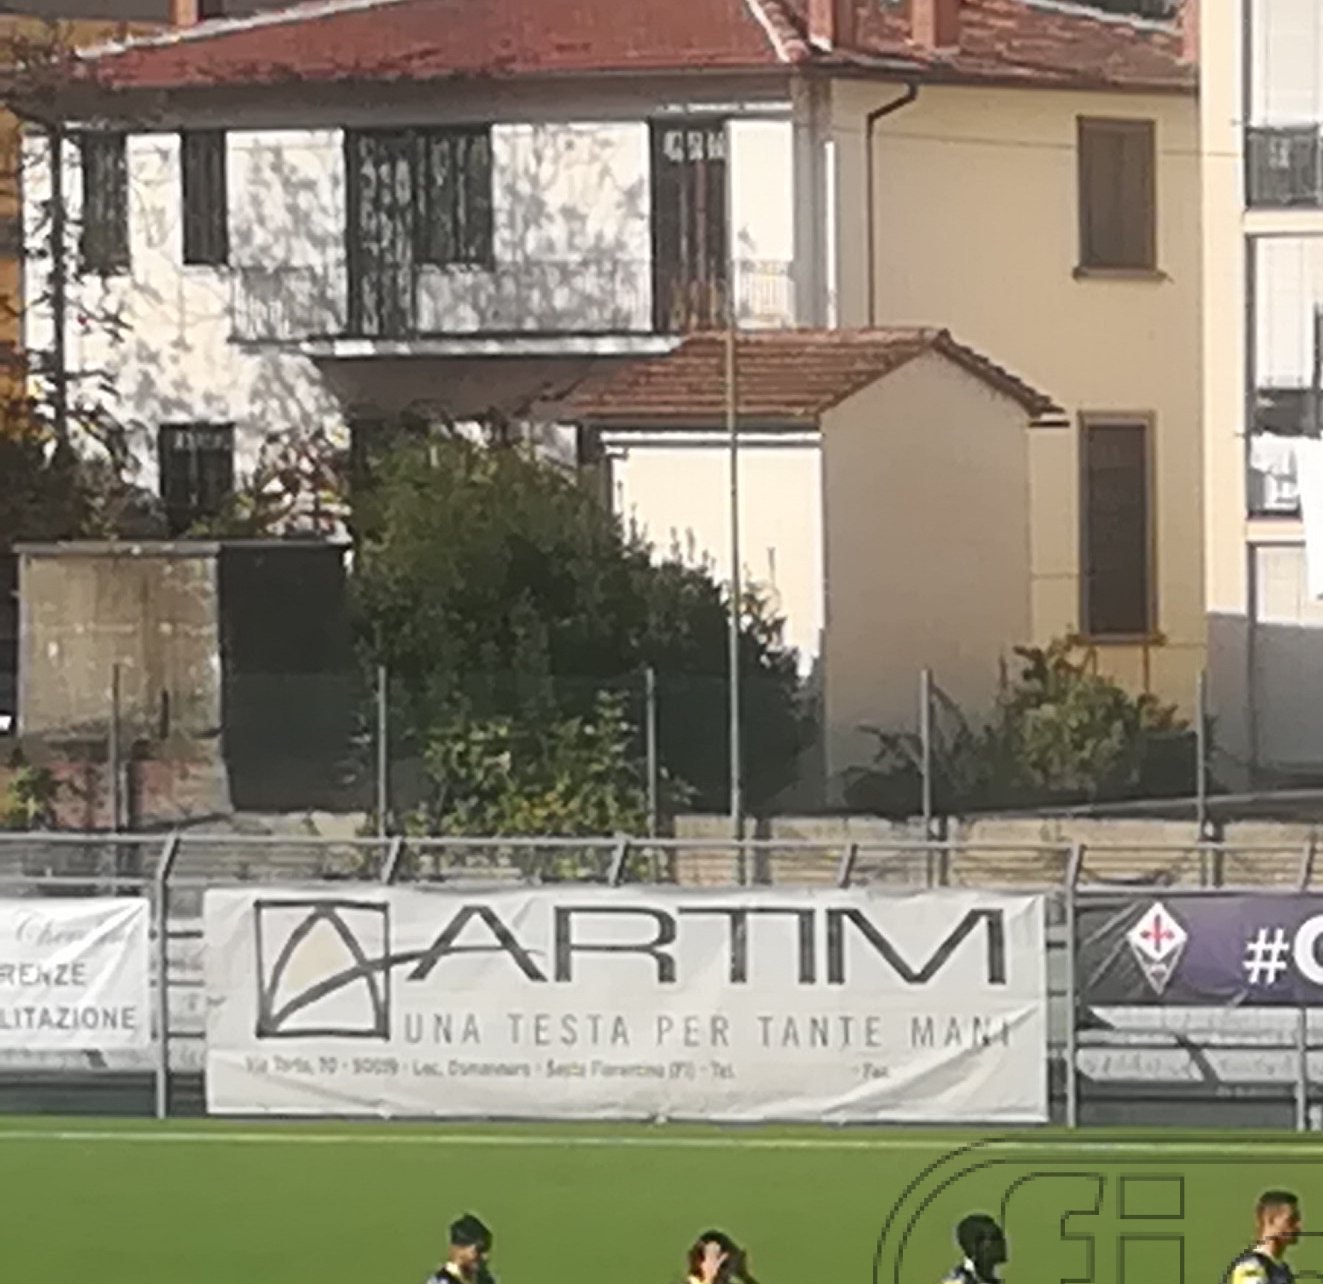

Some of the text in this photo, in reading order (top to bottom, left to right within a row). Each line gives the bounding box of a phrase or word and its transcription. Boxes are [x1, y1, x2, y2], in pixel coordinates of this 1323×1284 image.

[406, 905, 1006, 985] ARTIM
[404, 1013, 1010, 1048] UNA TESTA PER TANTE MANI
